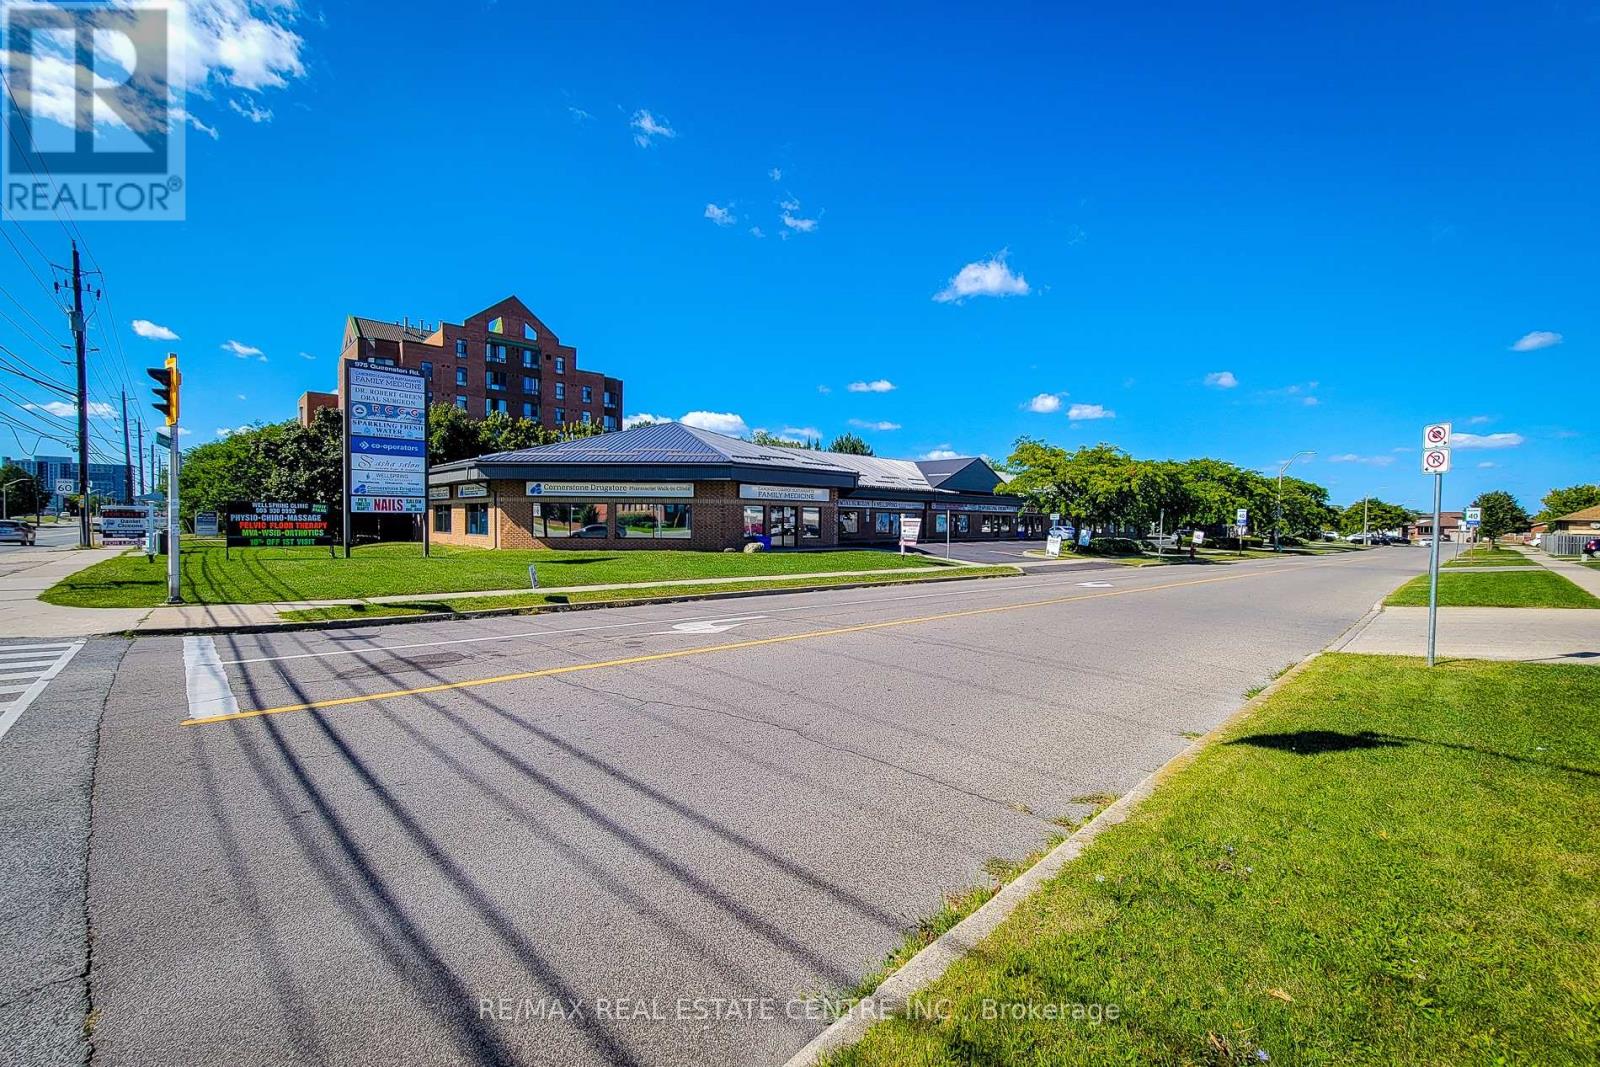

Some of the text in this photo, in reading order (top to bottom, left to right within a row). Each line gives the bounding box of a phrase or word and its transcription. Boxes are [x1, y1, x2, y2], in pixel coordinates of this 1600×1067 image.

[370, 364, 408, 374] Queenston
[355, 376, 384, 385] FAMILY
[386, 380, 422, 390] MEDICINE
[369, 389, 397, 397] ROBERT
[382, 398, 416, 406] SURGEON
[352, 420, 424, 432] SPARKLING FRESH
[370, 443, 419, 452] co-operators
[543, 483, 589, 491] Cornerstone
[590, 484, 627, 492] Drugstore
[784, 492, 815, 500] MEDICINE
[373, 498, 404, 512] NAILS
[239, 521, 328, 529] PELVIC FLOOR THERAPY
[266, 538, 280, 546] OFF
[296, 538, 316, 546] VISIT
